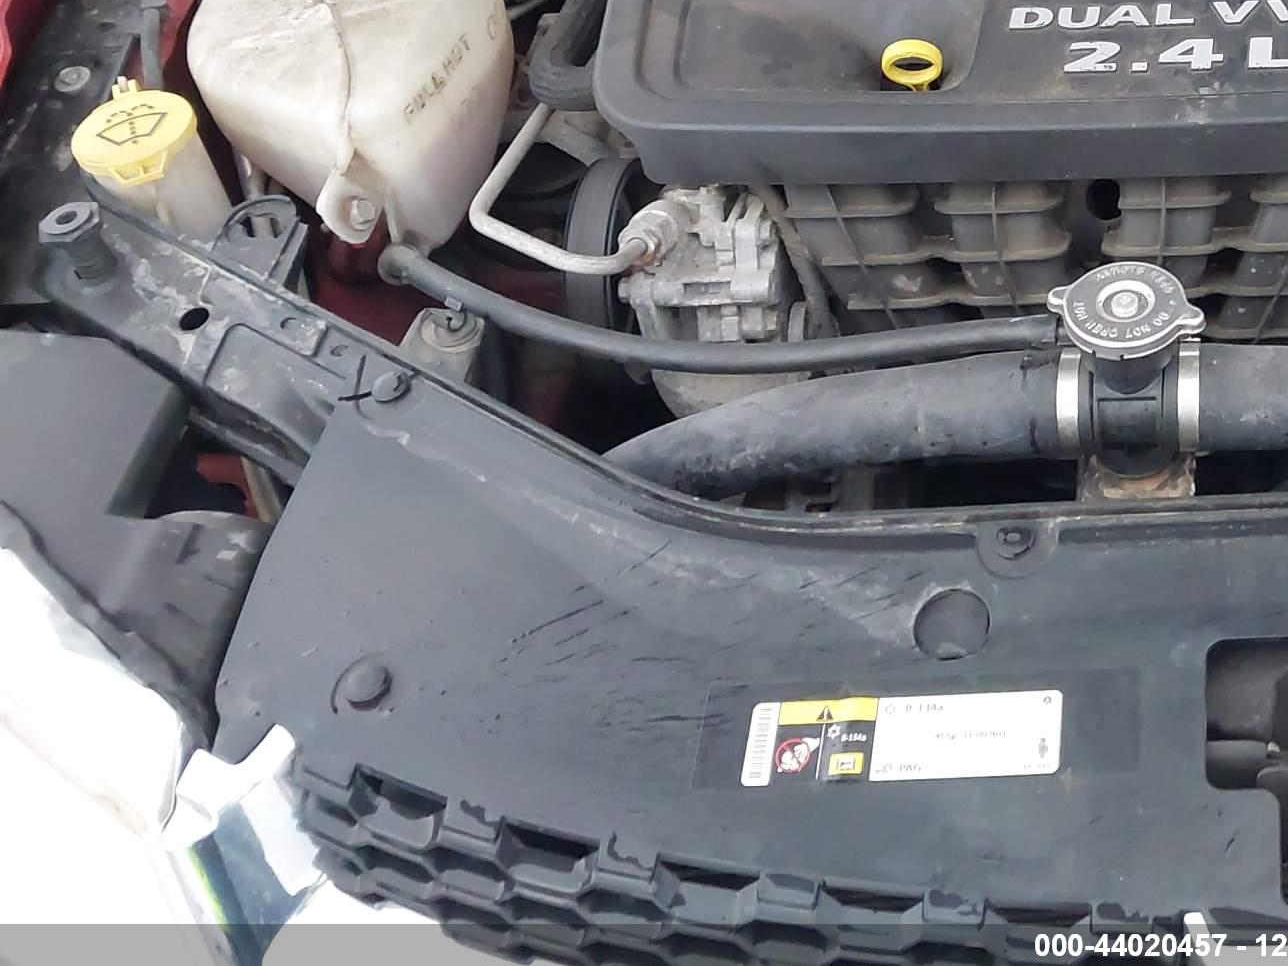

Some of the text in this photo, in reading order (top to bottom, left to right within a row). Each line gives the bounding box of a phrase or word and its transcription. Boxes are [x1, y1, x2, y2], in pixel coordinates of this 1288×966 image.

[1008, 3, 1195, 29] DUAL
[1085, 319, 1119, 339] OPEN
[1125, 323, 1152, 339] NOT
